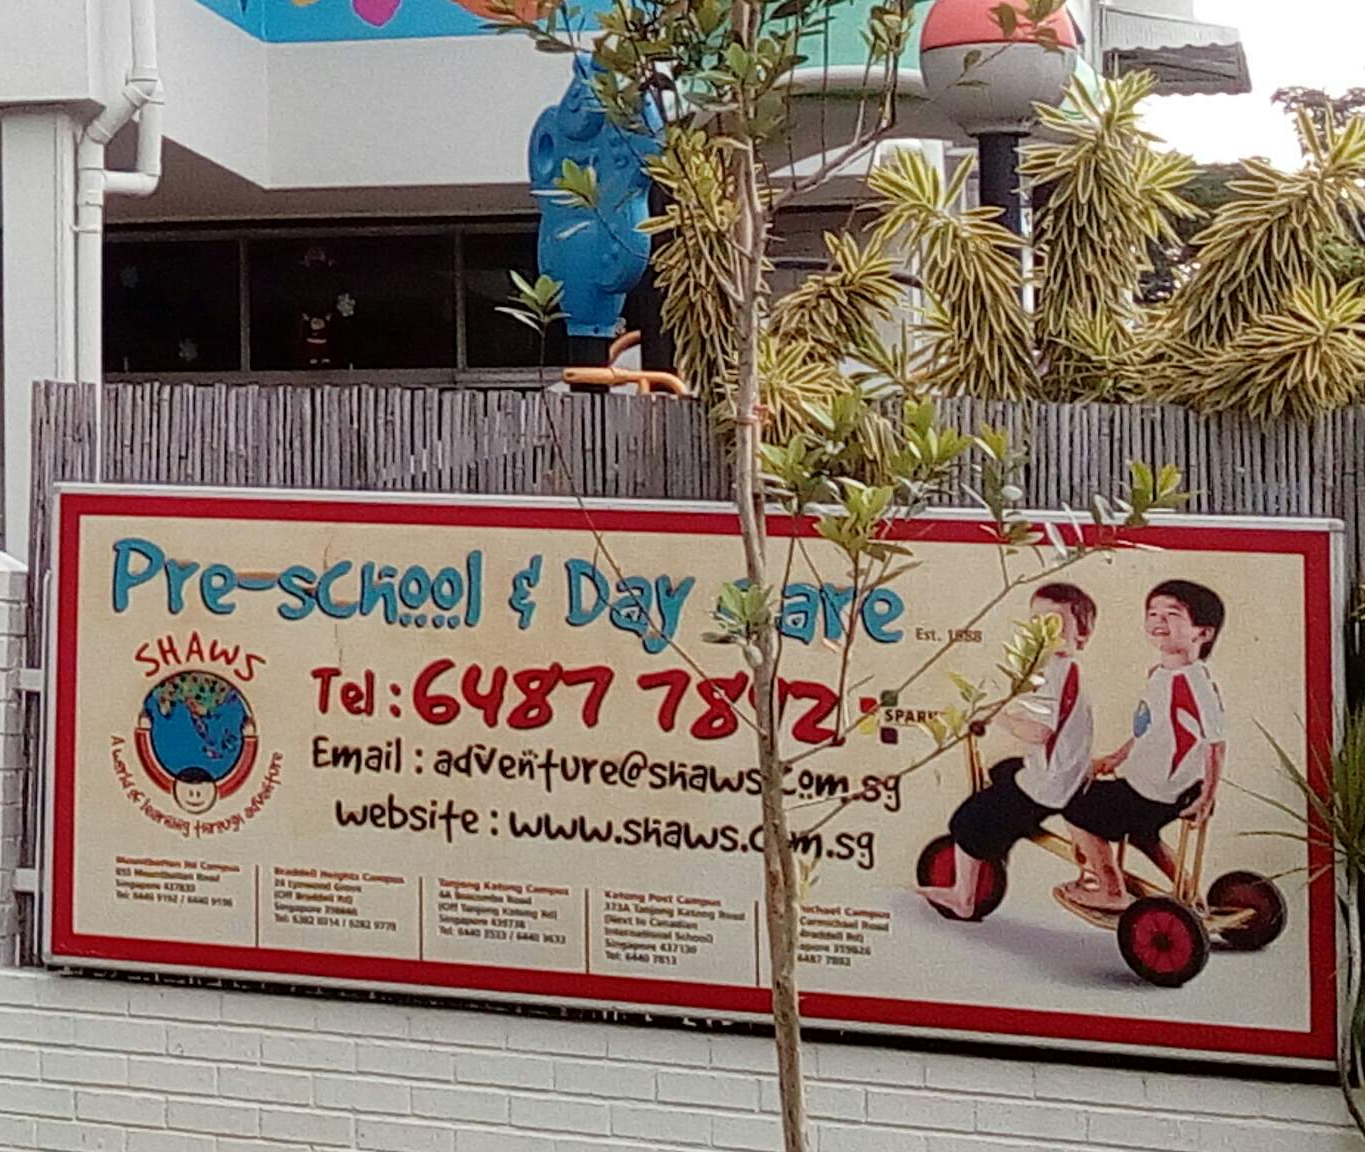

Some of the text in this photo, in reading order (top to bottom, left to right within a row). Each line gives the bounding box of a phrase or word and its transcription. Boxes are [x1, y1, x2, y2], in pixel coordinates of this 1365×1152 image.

[507, 554, 543, 630] &
[566, 558, 696, 654] Day
[717, 577, 905, 645] are
[134, 630, 267, 682] SHAWS
[413, 658, 615, 730] 6487
[510, 810, 875, 870] www.shaws.cm.sg
